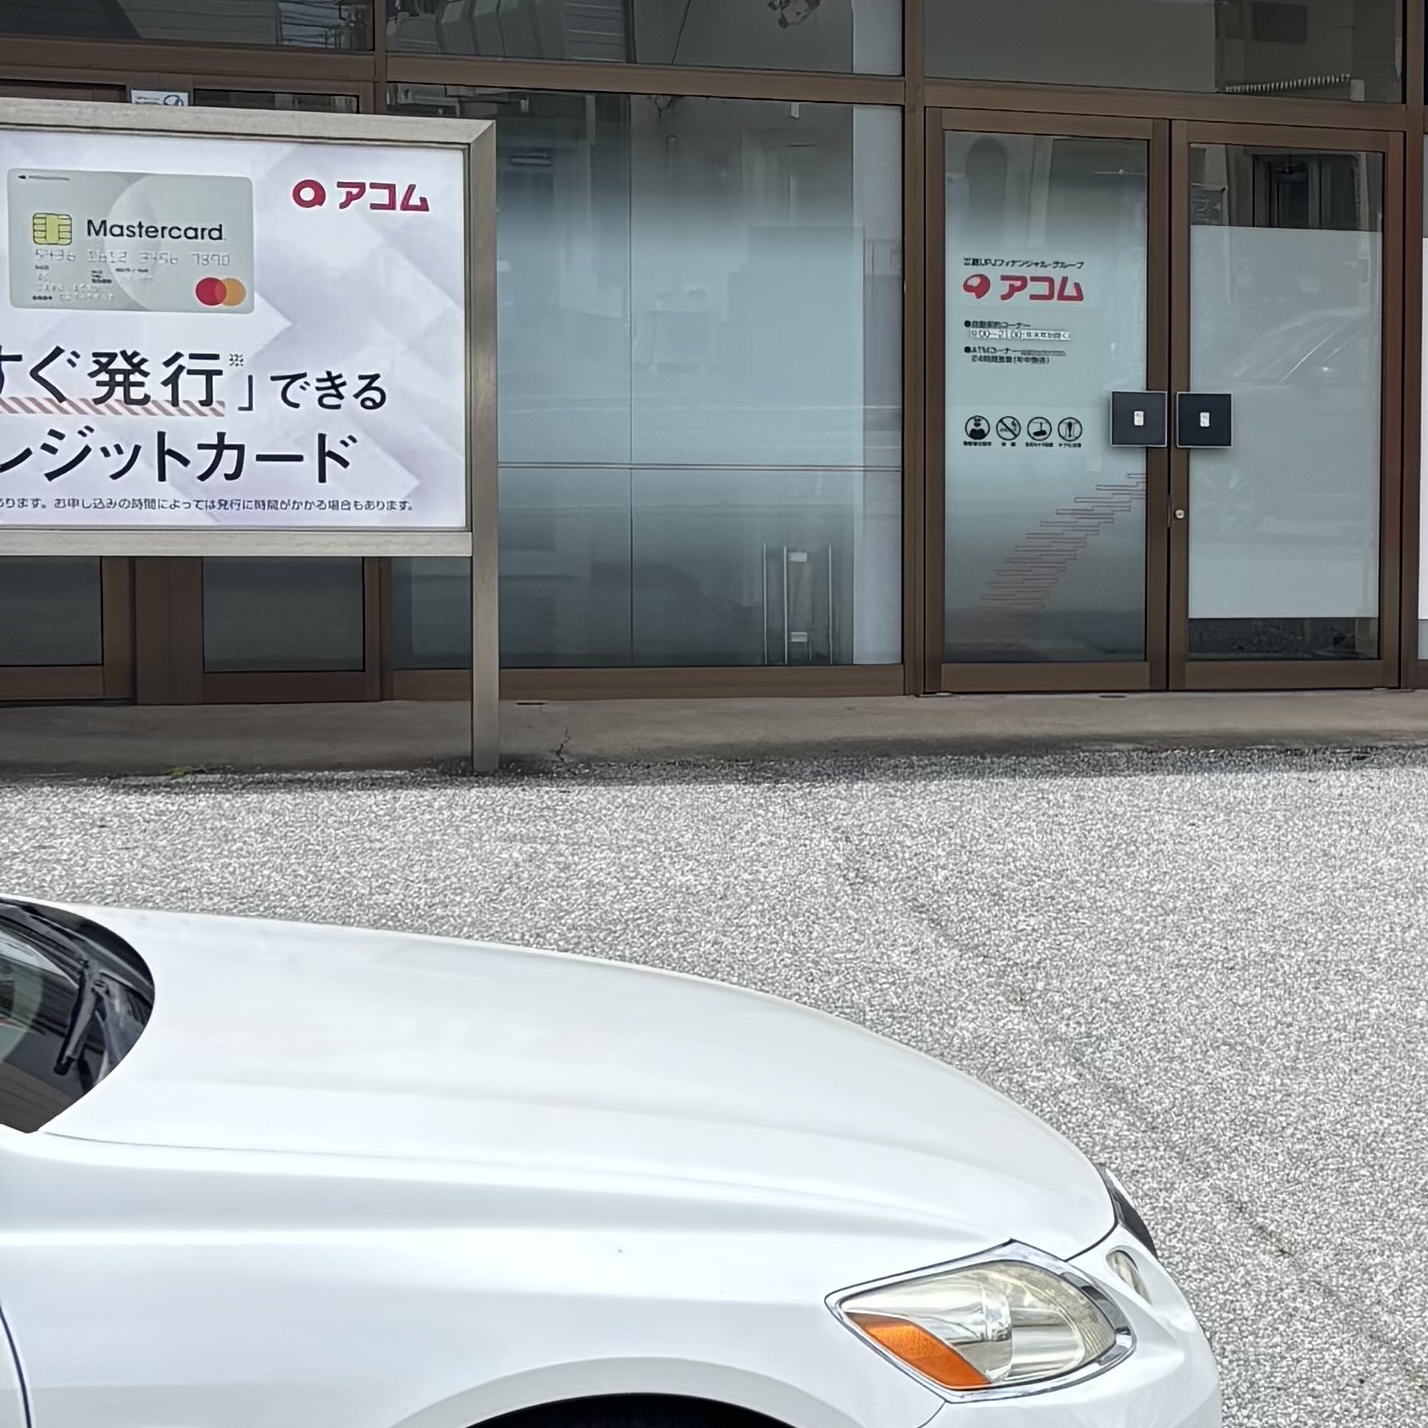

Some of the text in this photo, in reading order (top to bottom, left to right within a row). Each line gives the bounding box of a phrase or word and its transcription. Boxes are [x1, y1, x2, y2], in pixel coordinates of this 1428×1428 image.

[336, 180, 430, 212] アコム
[86, 219, 224, 242] Mastercard
[1000, 274, 1084, 302] アコム
